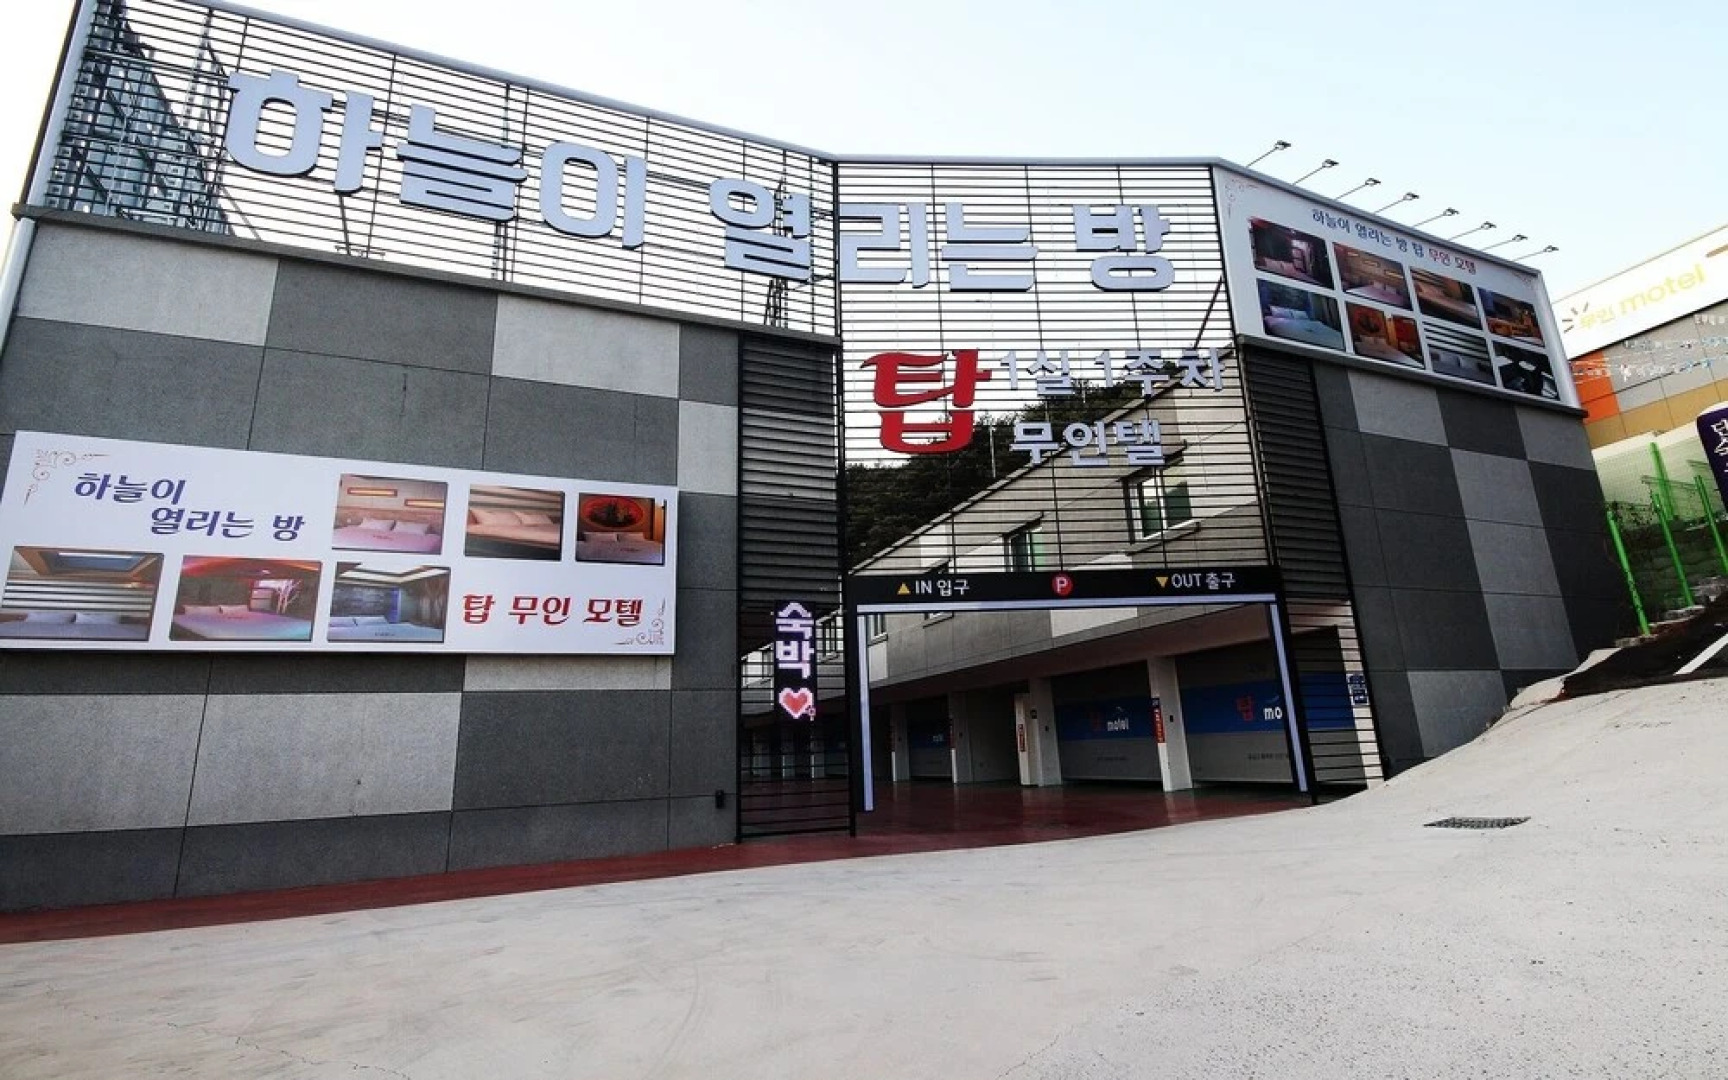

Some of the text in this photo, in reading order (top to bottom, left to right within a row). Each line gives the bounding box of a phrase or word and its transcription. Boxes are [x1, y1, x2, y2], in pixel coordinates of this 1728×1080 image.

[224, 69, 1175, 292] 하늘이 열리는 방
[1312, 208, 1351, 234] 하늘이
[1355, 221, 1393, 248] 열리는
[1395, 236, 1408, 252] 방
[1412, 242, 1424, 258] 탑
[1429, 248, 1451, 267] 무인
[1618, 263, 1706, 316] motel
[1000, 348, 1226, 398] 1실 1주차
[860, 348, 992, 454] 탑
[74, 472, 186, 505] 하늘이
[150, 507, 306, 542] 열리는 방
[914, 578, 971, 596] IN 입구
[1056, 578, 1070, 594] P
[1171, 571, 1237, 589] OUT 출구
[463, 594, 644, 628] 탑 무인 모텔
[776, 602, 815, 680] 숙박
